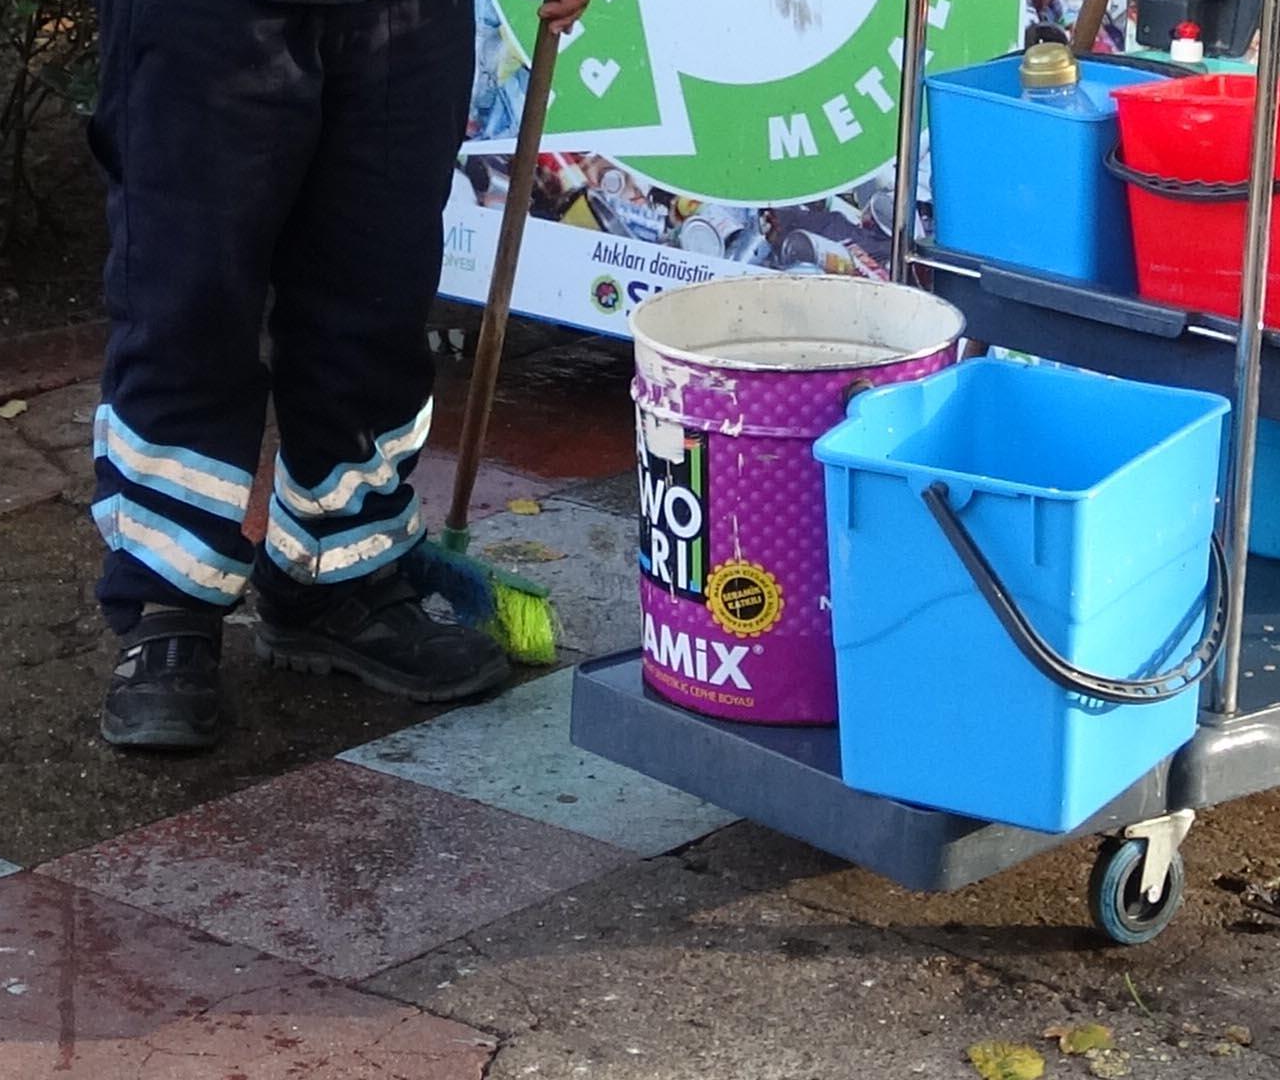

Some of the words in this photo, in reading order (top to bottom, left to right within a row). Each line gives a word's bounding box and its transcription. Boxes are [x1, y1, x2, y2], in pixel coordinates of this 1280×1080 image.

[591, 241, 647, 273] Atıkları
[638, 463, 703, 539] WO
[651, 526, 688, 590] RI
[718, 693, 755, 708] BOYASI
